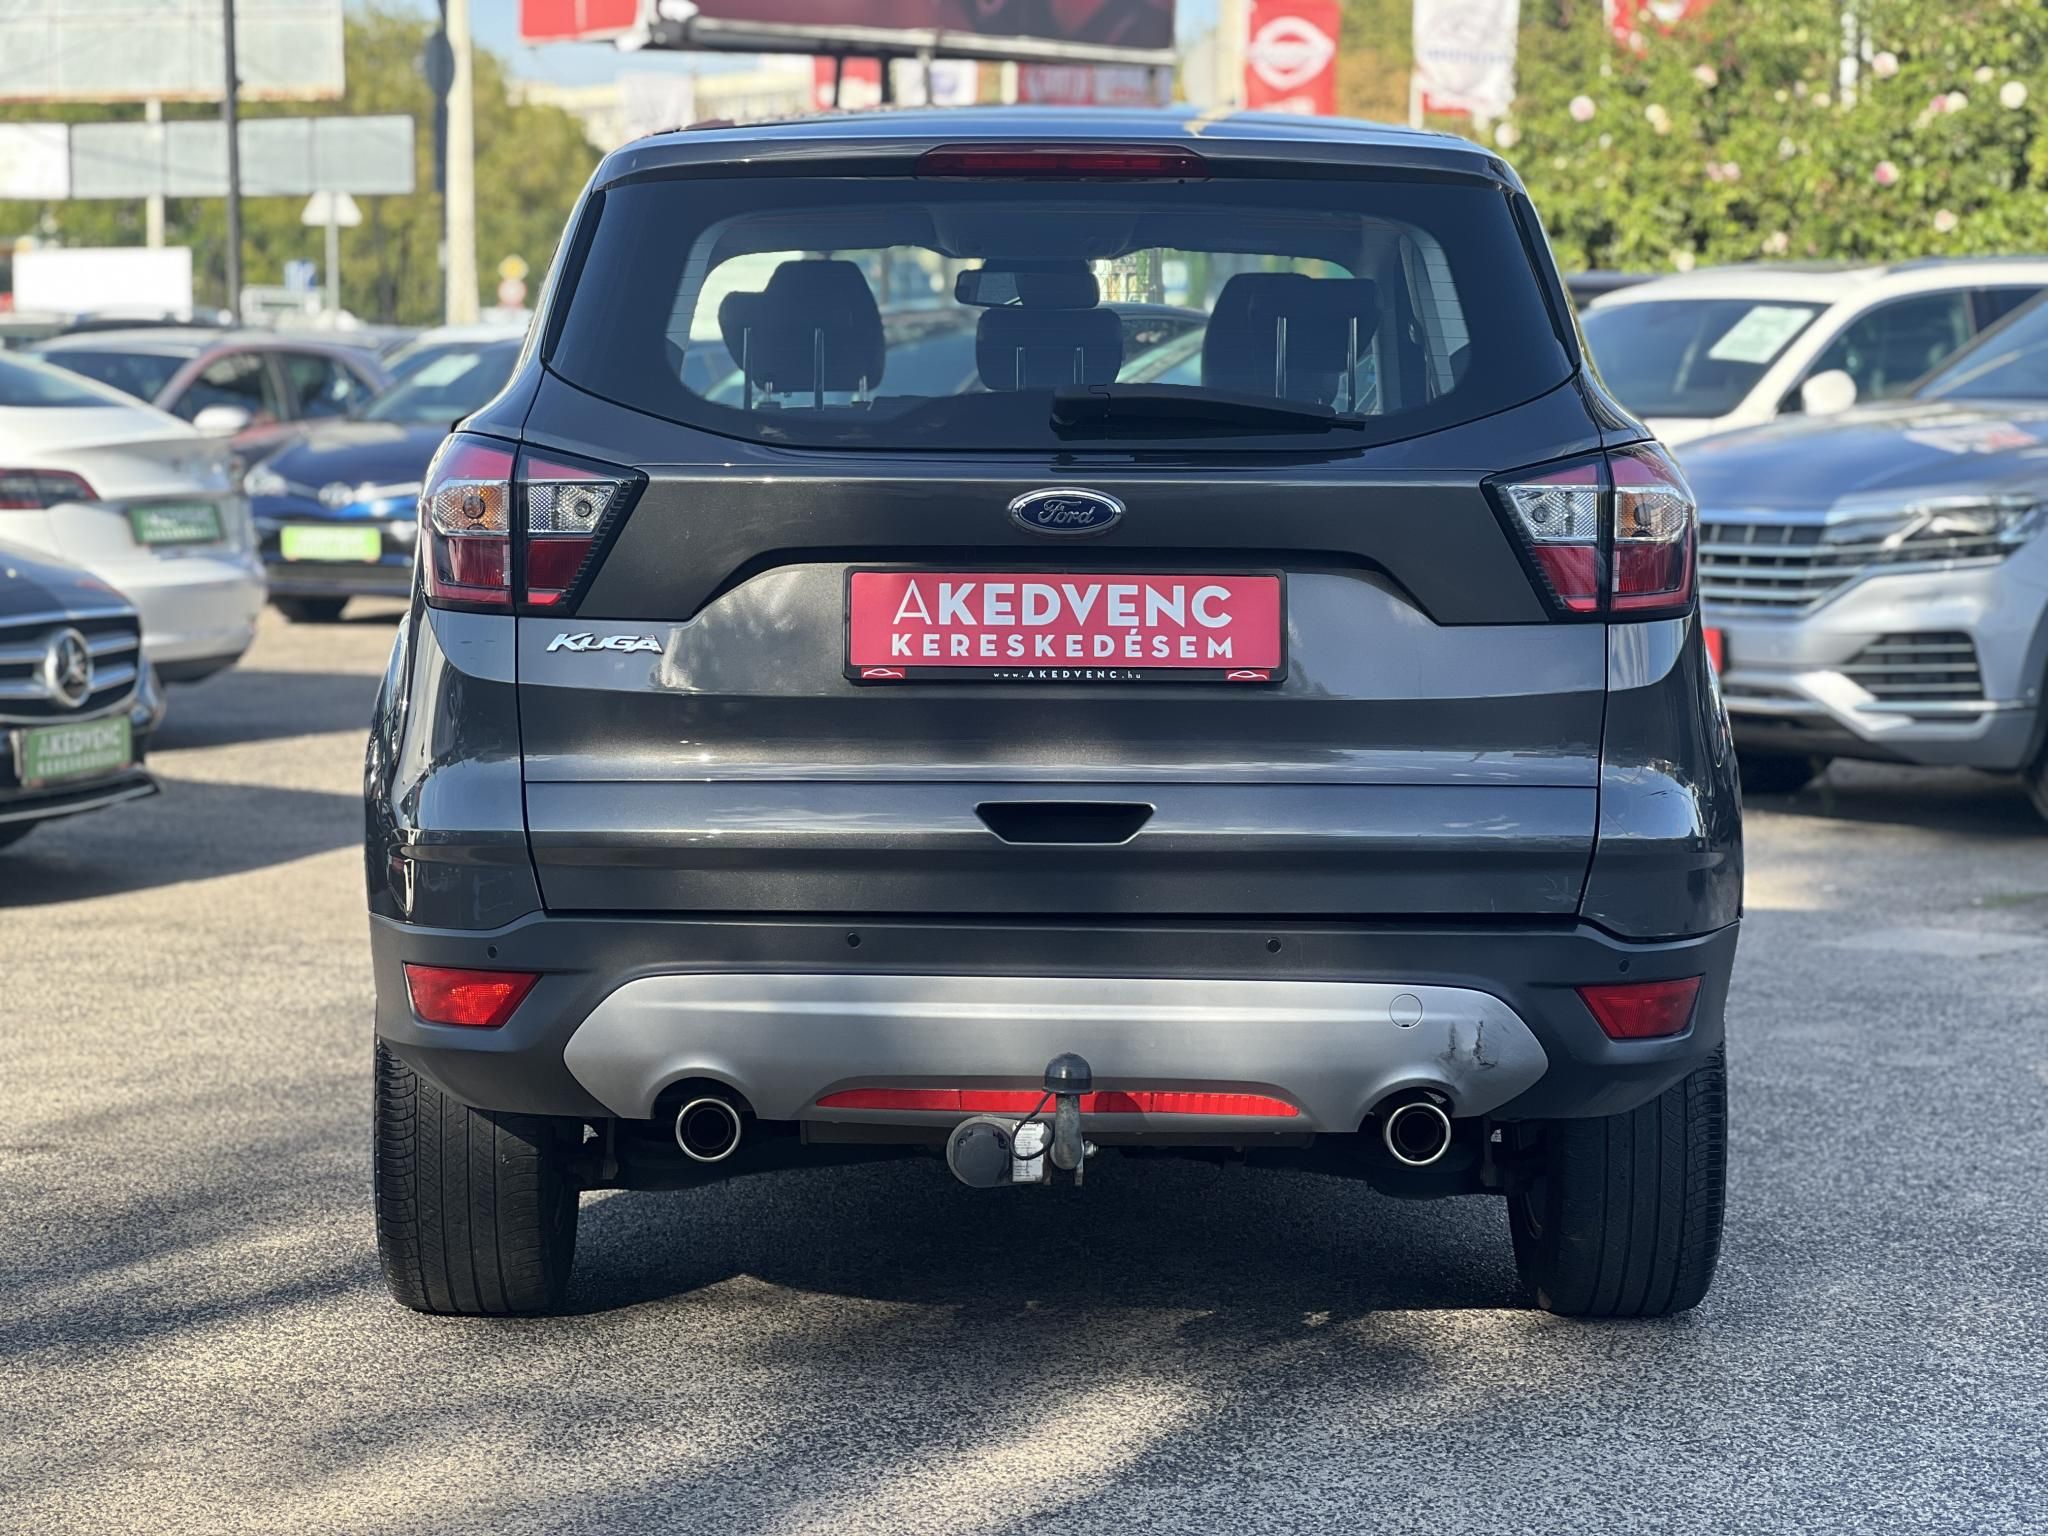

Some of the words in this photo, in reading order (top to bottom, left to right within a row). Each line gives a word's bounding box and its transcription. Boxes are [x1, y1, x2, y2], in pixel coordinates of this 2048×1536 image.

[1037, 499, 1096, 524] Ford
[546, 632, 664, 654] KUGA
[891, 628, 1233, 659] KERESKEDÉSEM
[993, 669, 1142, 680] www.AKEDVENC.hu
